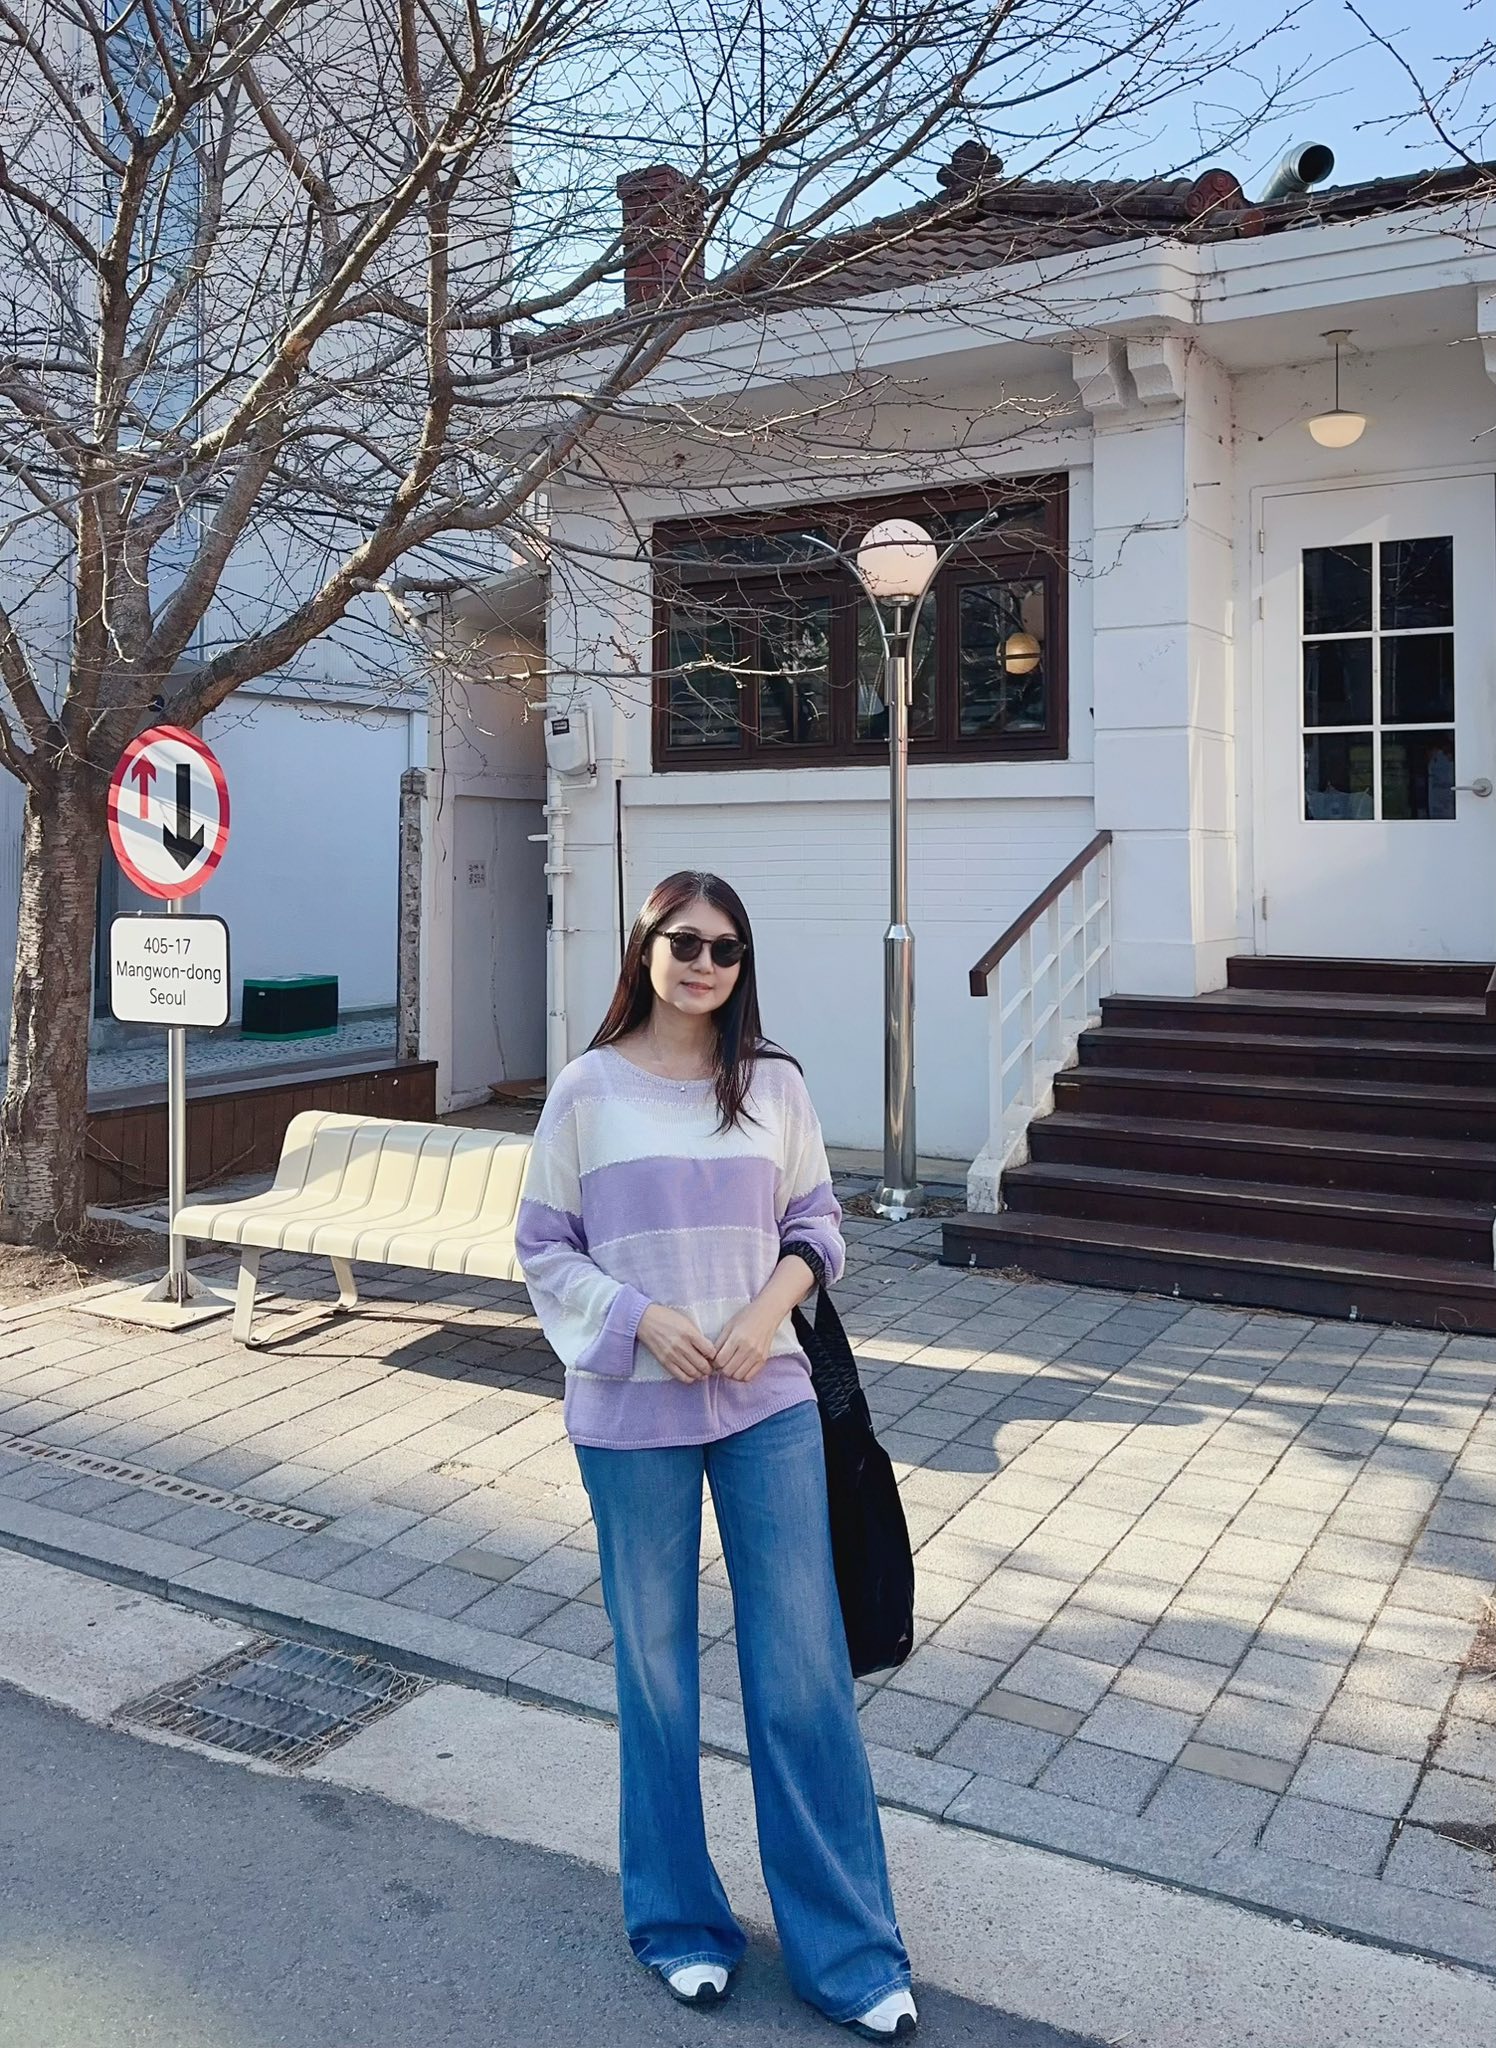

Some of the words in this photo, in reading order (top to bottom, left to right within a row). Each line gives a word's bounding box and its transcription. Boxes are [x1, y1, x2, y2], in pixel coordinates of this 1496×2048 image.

[143, 937, 191, 955] 405-17
[116, 960, 221, 984] Mangwon-dong
[149, 987, 186, 1006] Seoul
